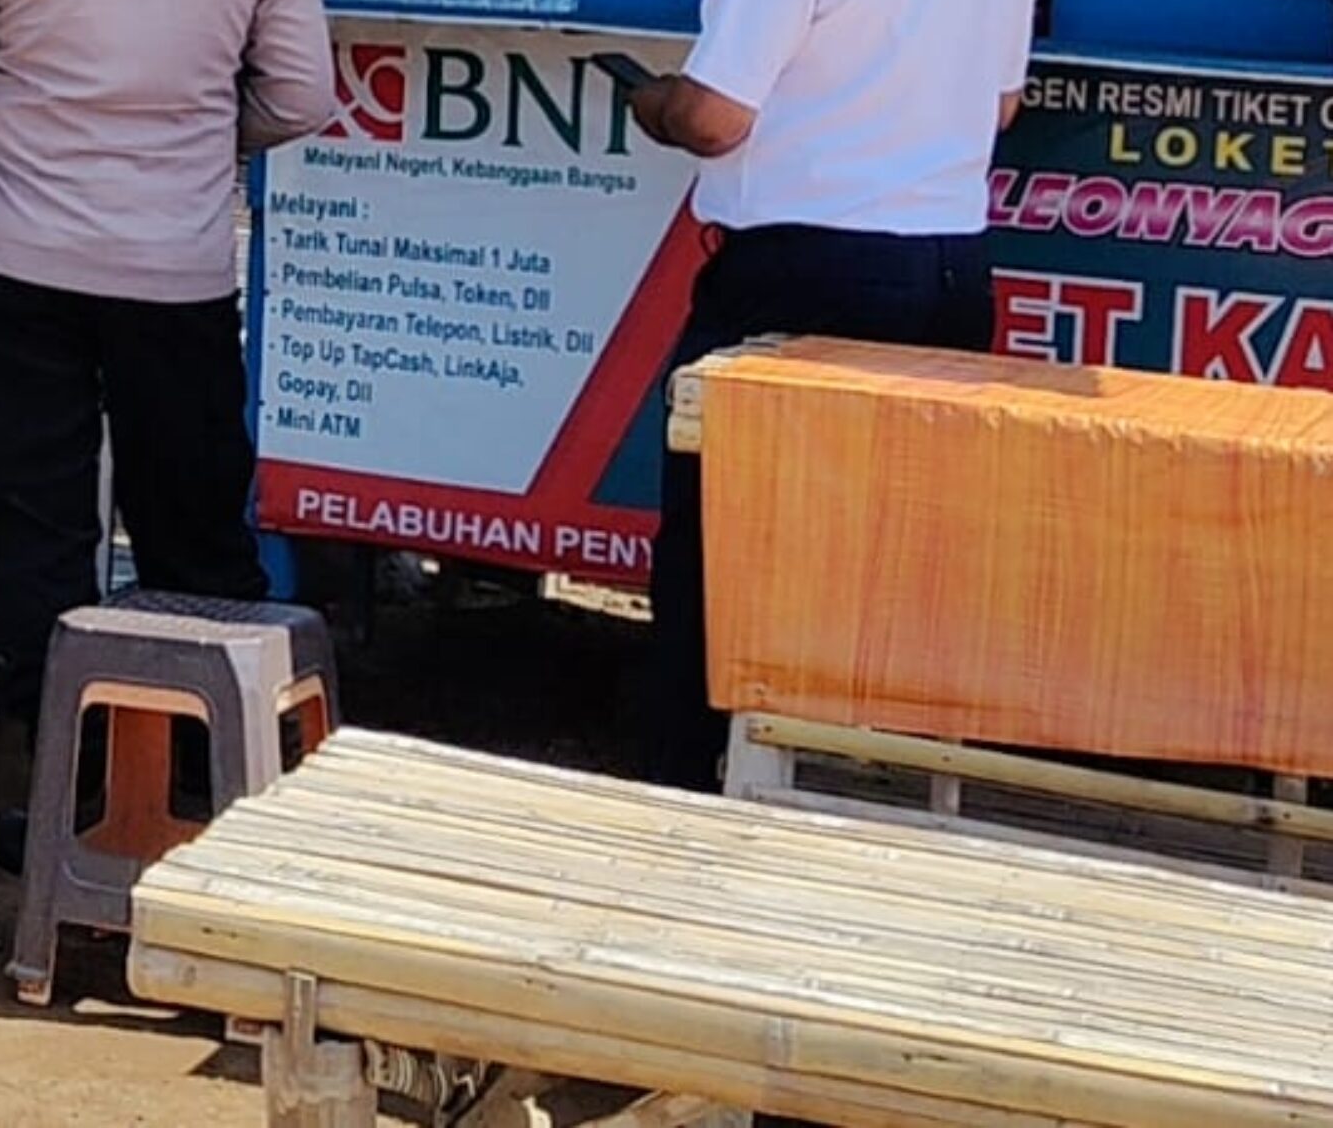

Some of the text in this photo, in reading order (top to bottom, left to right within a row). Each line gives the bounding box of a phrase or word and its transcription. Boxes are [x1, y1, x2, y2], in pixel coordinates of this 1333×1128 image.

[420, 47, 630, 156] BNI
[1099, 82, 1201, 119] RESMI
[1212, 88, 1312, 127] TIKET
[304, 147, 636, 193] Melayani Negeri, Kebanggaan Bangsa
[270, 193, 357, 220] Melayani
[283, 228, 329, 251] Tarik
[335, 232, 387, 257] Tunai
[393, 237, 484, 265] Maksimal
[492, 248, 500, 267] 1
[506, 251, 550, 273] Juta
[283, 263, 382, 293] Pembelian
[388, 274, 445, 302] Pulsa,
[453, 281, 517, 309] Token,
[523, 287, 550, 311] Dll
[282, 299, 398, 333] Pembayaran
[406, 313, 486, 344] Telepon,
[282, 335, 314, 363] Top
[319, 340, 345, 366] Up
[353, 344, 438, 377] TapCash,
[445, 355, 523, 388] LinkAja,
[278, 372, 340, 403] Gopay,
[277, 407, 314, 431] Mini
[320, 414, 361, 438] ATM
[296, 488, 540, 554] PELABUHAN
